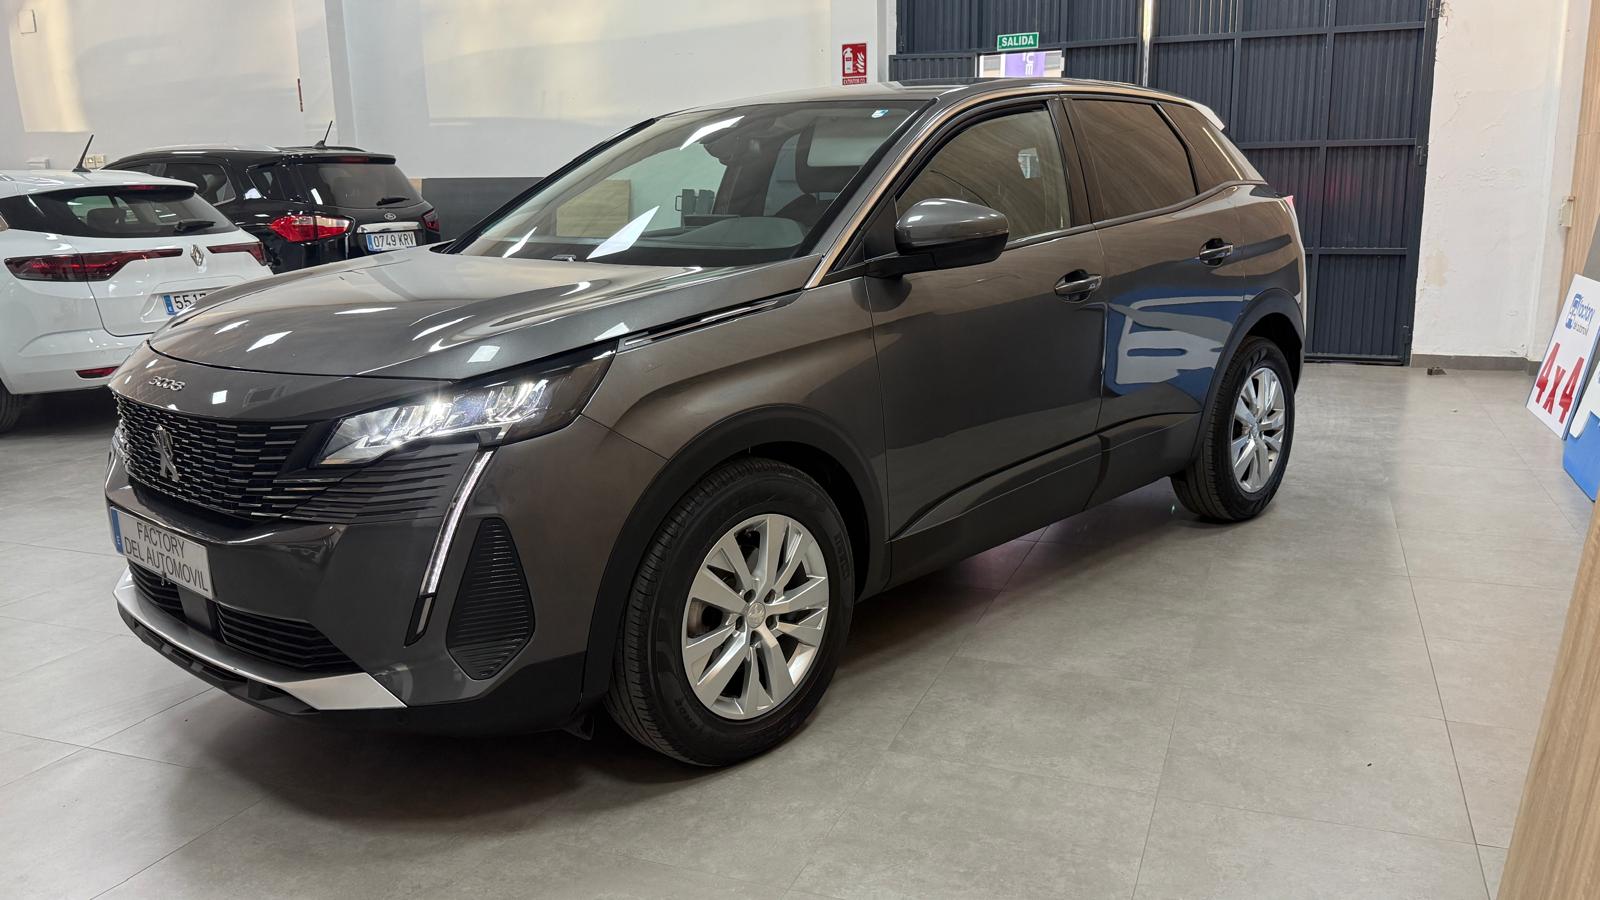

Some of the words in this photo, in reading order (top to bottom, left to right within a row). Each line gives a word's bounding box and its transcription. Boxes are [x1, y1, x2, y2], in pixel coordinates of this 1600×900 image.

[1001, 35, 1034, 47] SALIDA
[373, 234, 396, 248] 0749
[398, 233, 414, 246] KRV
[1535, 342, 1584, 424] 4x4
[136, 521, 185, 558] FACTORY
[124, 536, 145, 562] DEL
[146, 547, 209, 592] AUTOMOVIL
